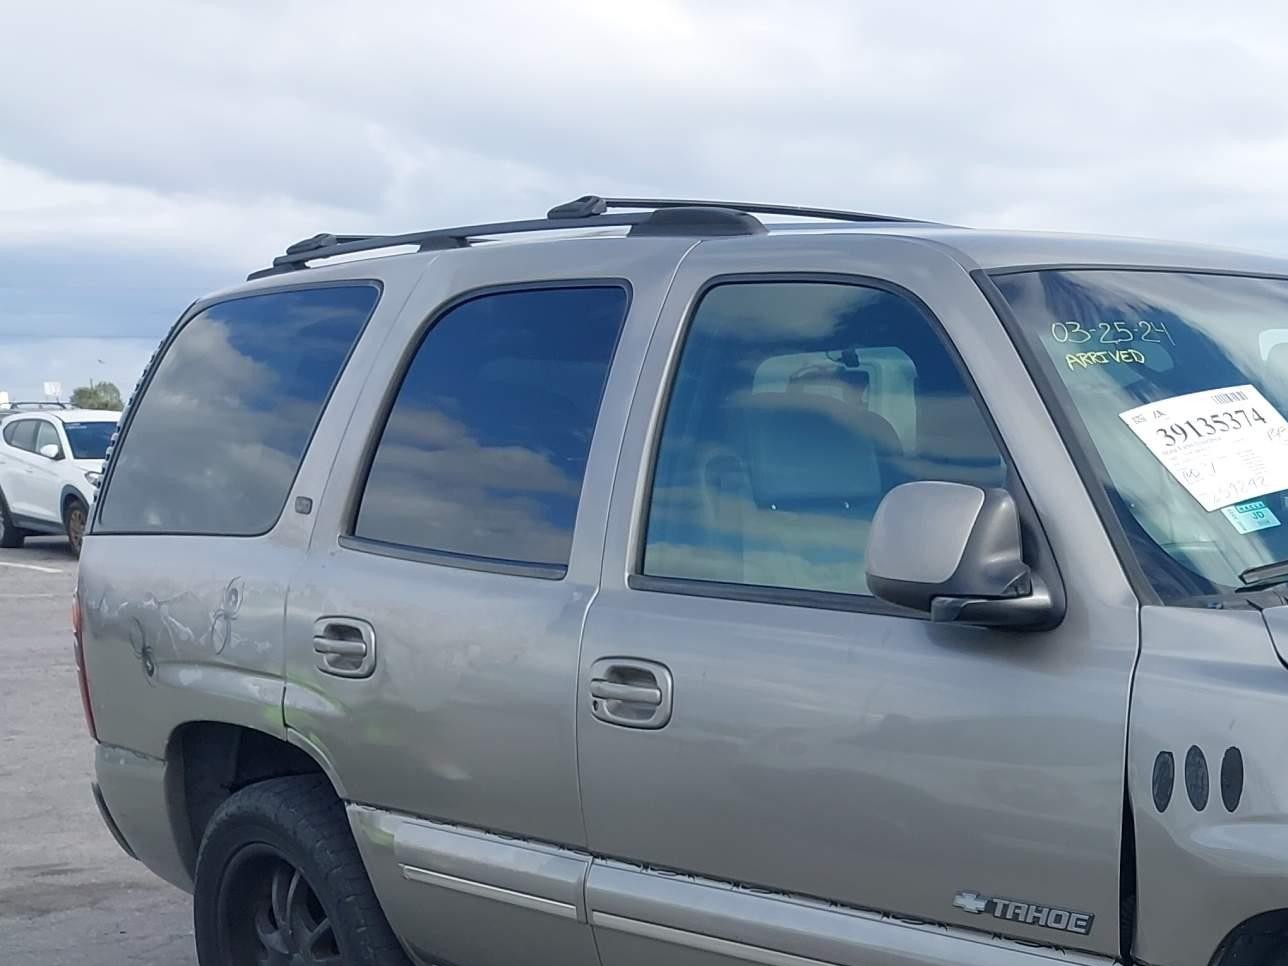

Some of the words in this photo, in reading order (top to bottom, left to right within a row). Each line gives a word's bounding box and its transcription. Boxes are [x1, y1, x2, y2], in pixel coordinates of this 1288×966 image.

[1051, 320, 1177, 346] 03-25-24
[1065, 349, 1145, 371] ARRIVED
[1156, 407, 1267, 447] 39135374
[992, 898, 1090, 933] TAHOE
